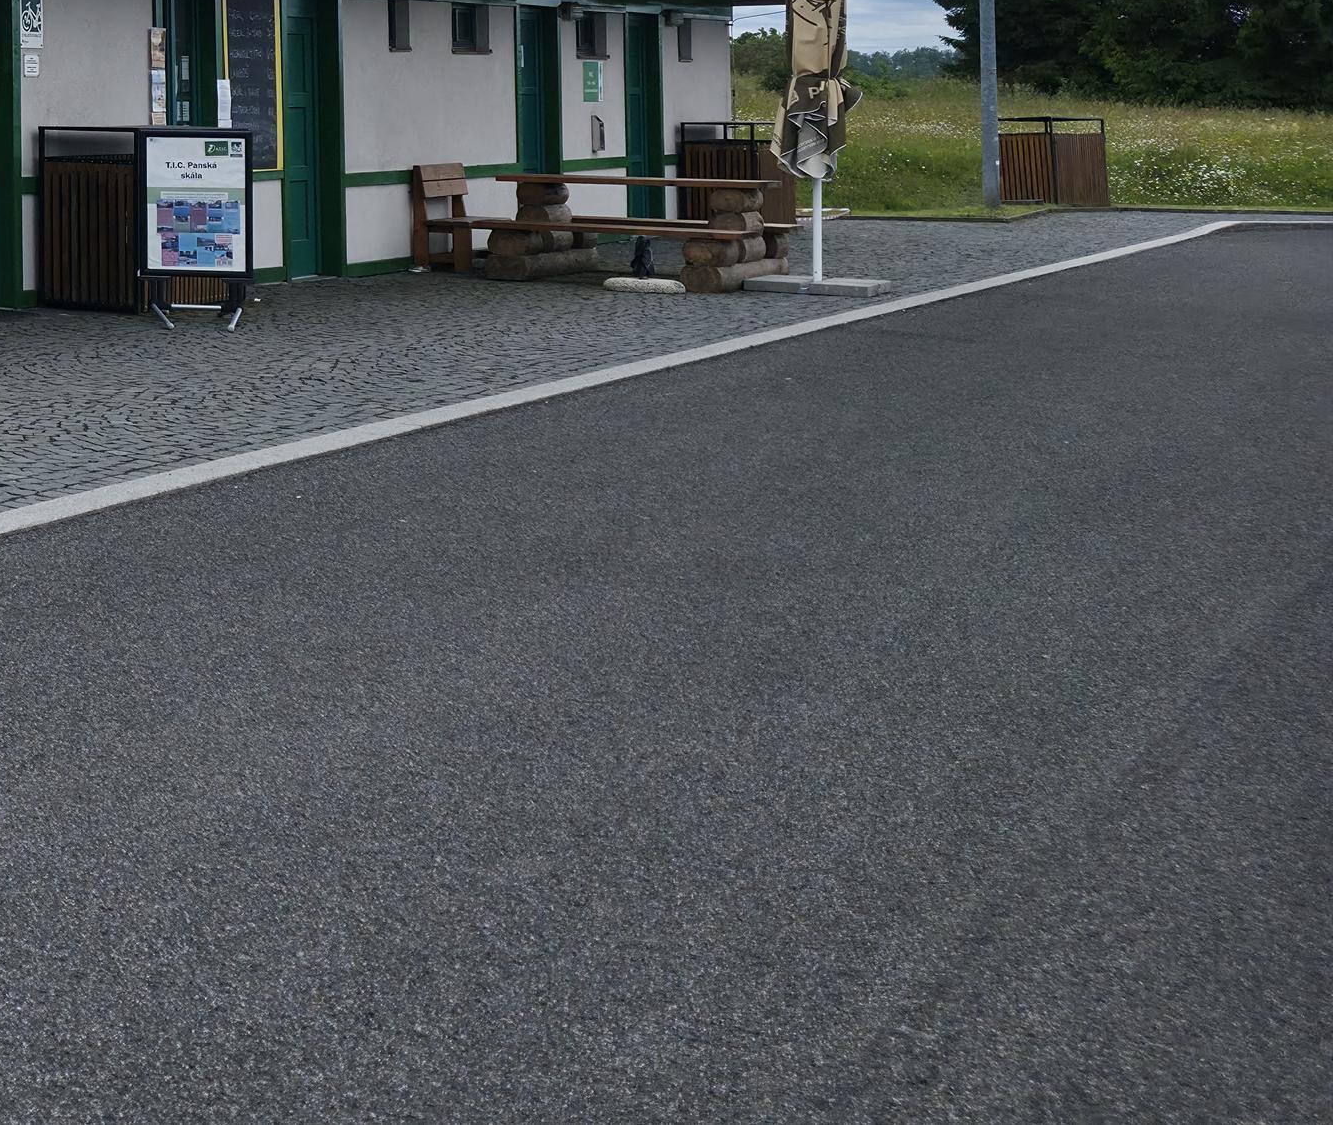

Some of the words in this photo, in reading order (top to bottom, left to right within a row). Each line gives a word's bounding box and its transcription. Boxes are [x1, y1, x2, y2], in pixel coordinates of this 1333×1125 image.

[165, 161, 185, 169] T.I.C.
[187, 161, 217, 169] Panská
[180, 172, 203, 180] skála
